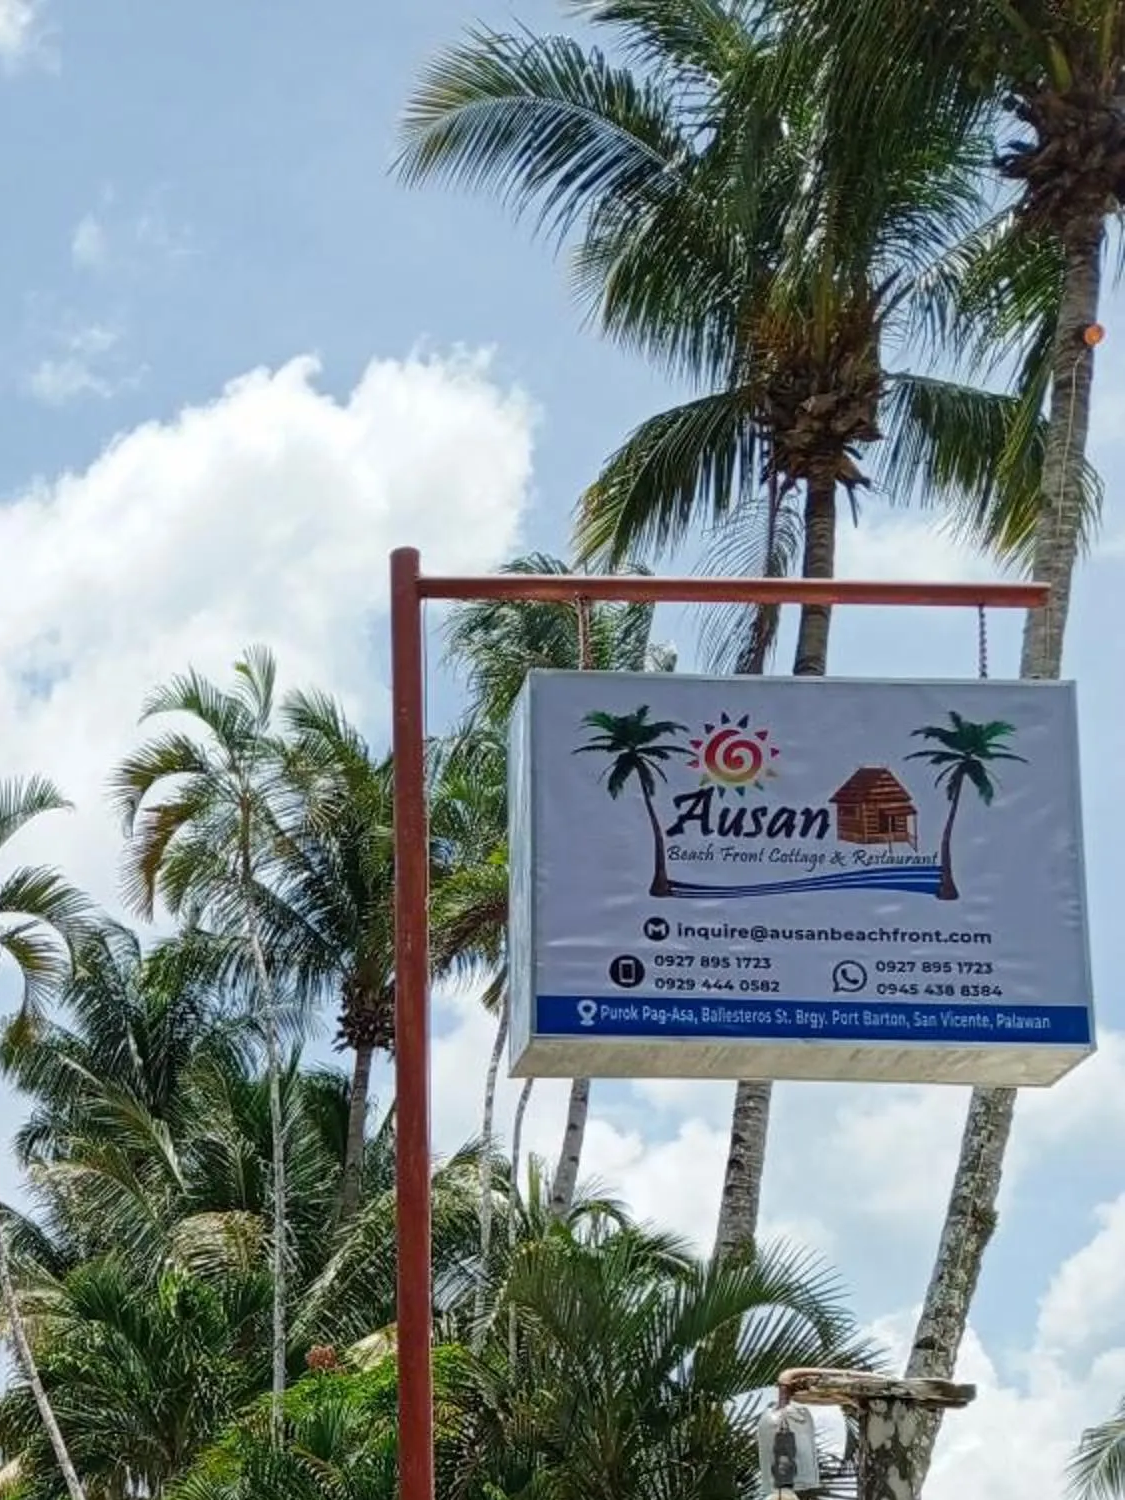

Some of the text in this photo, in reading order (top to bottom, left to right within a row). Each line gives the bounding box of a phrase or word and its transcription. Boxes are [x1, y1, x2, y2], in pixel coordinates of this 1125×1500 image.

[665, 786, 831, 841] Ausan
[667, 843, 940, 872] Beach Front Cottage & Restaurant
[677, 922, 992, 945] inquire@ausanbeachfront.com
[654, 955, 772, 970] 0927 895 1723
[876, 960, 994, 975] 0927 895 1723
[654, 977, 780, 993] 0929 444 0582
[876, 983, 1004, 997] 0945 438 8384
[600, 1005, 1052, 1030] Purok Pag-Asa, Ballesteros St. Brgy. Port Barton, San Vicente, Palawan
